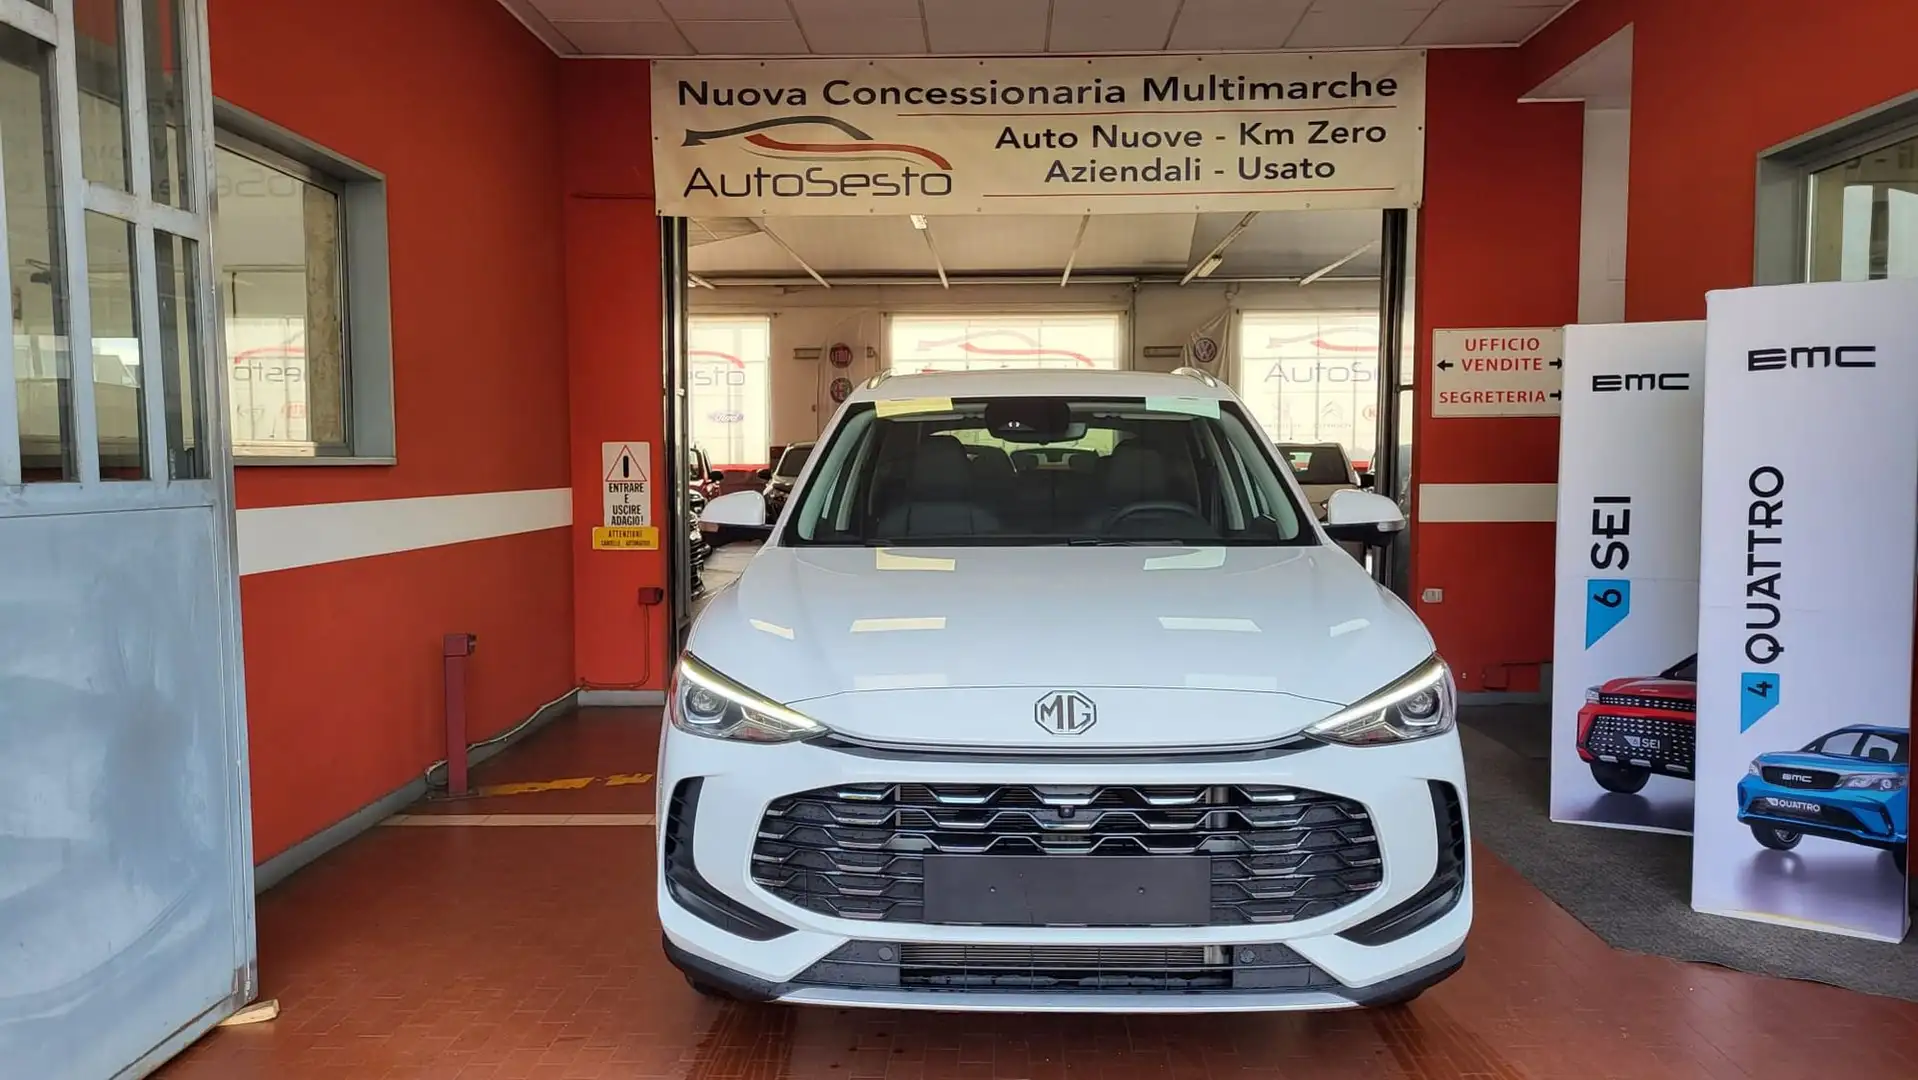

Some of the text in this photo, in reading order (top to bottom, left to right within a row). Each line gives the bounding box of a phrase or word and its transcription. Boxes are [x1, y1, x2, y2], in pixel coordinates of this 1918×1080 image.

[678, 71, 1398, 106] Nuova Concessionaria Multimarche
[995, 126, 1079, 149] Auto
[1092, 124, 1203, 149] Nuove
[1240, 122, 1294, 146] Km
[1307, 120, 1387, 145] Zero
[1044, 156, 1201, 183] Aziendali
[1238, 156, 1336, 181] Usato
[683, 166, 953, 198] AutoSesto
[1465, 337, 1540, 352] UFFICIO
[1264, 361, 1377, 383] AutoS
[1461, 357, 1543, 372] VENDITE
[689, 366, 746, 386] sto
[1438, 390, 1546, 404] SEGRETERIA
[608, 483, 644, 493] ENTRARE
[624, 494, 630, 504] E
[612, 505, 642, 515] USCIRE
[611, 516, 644, 526] ADAGIO!
[1590, 496, 1632, 608] 6 SEI
[1744, 465, 1785, 698] 4 QUATTRO
[1039, 694, 1092, 731] MG
[1641, 738, 1661, 750] SEI
[1778, 799, 1821, 813] QUATTRO
